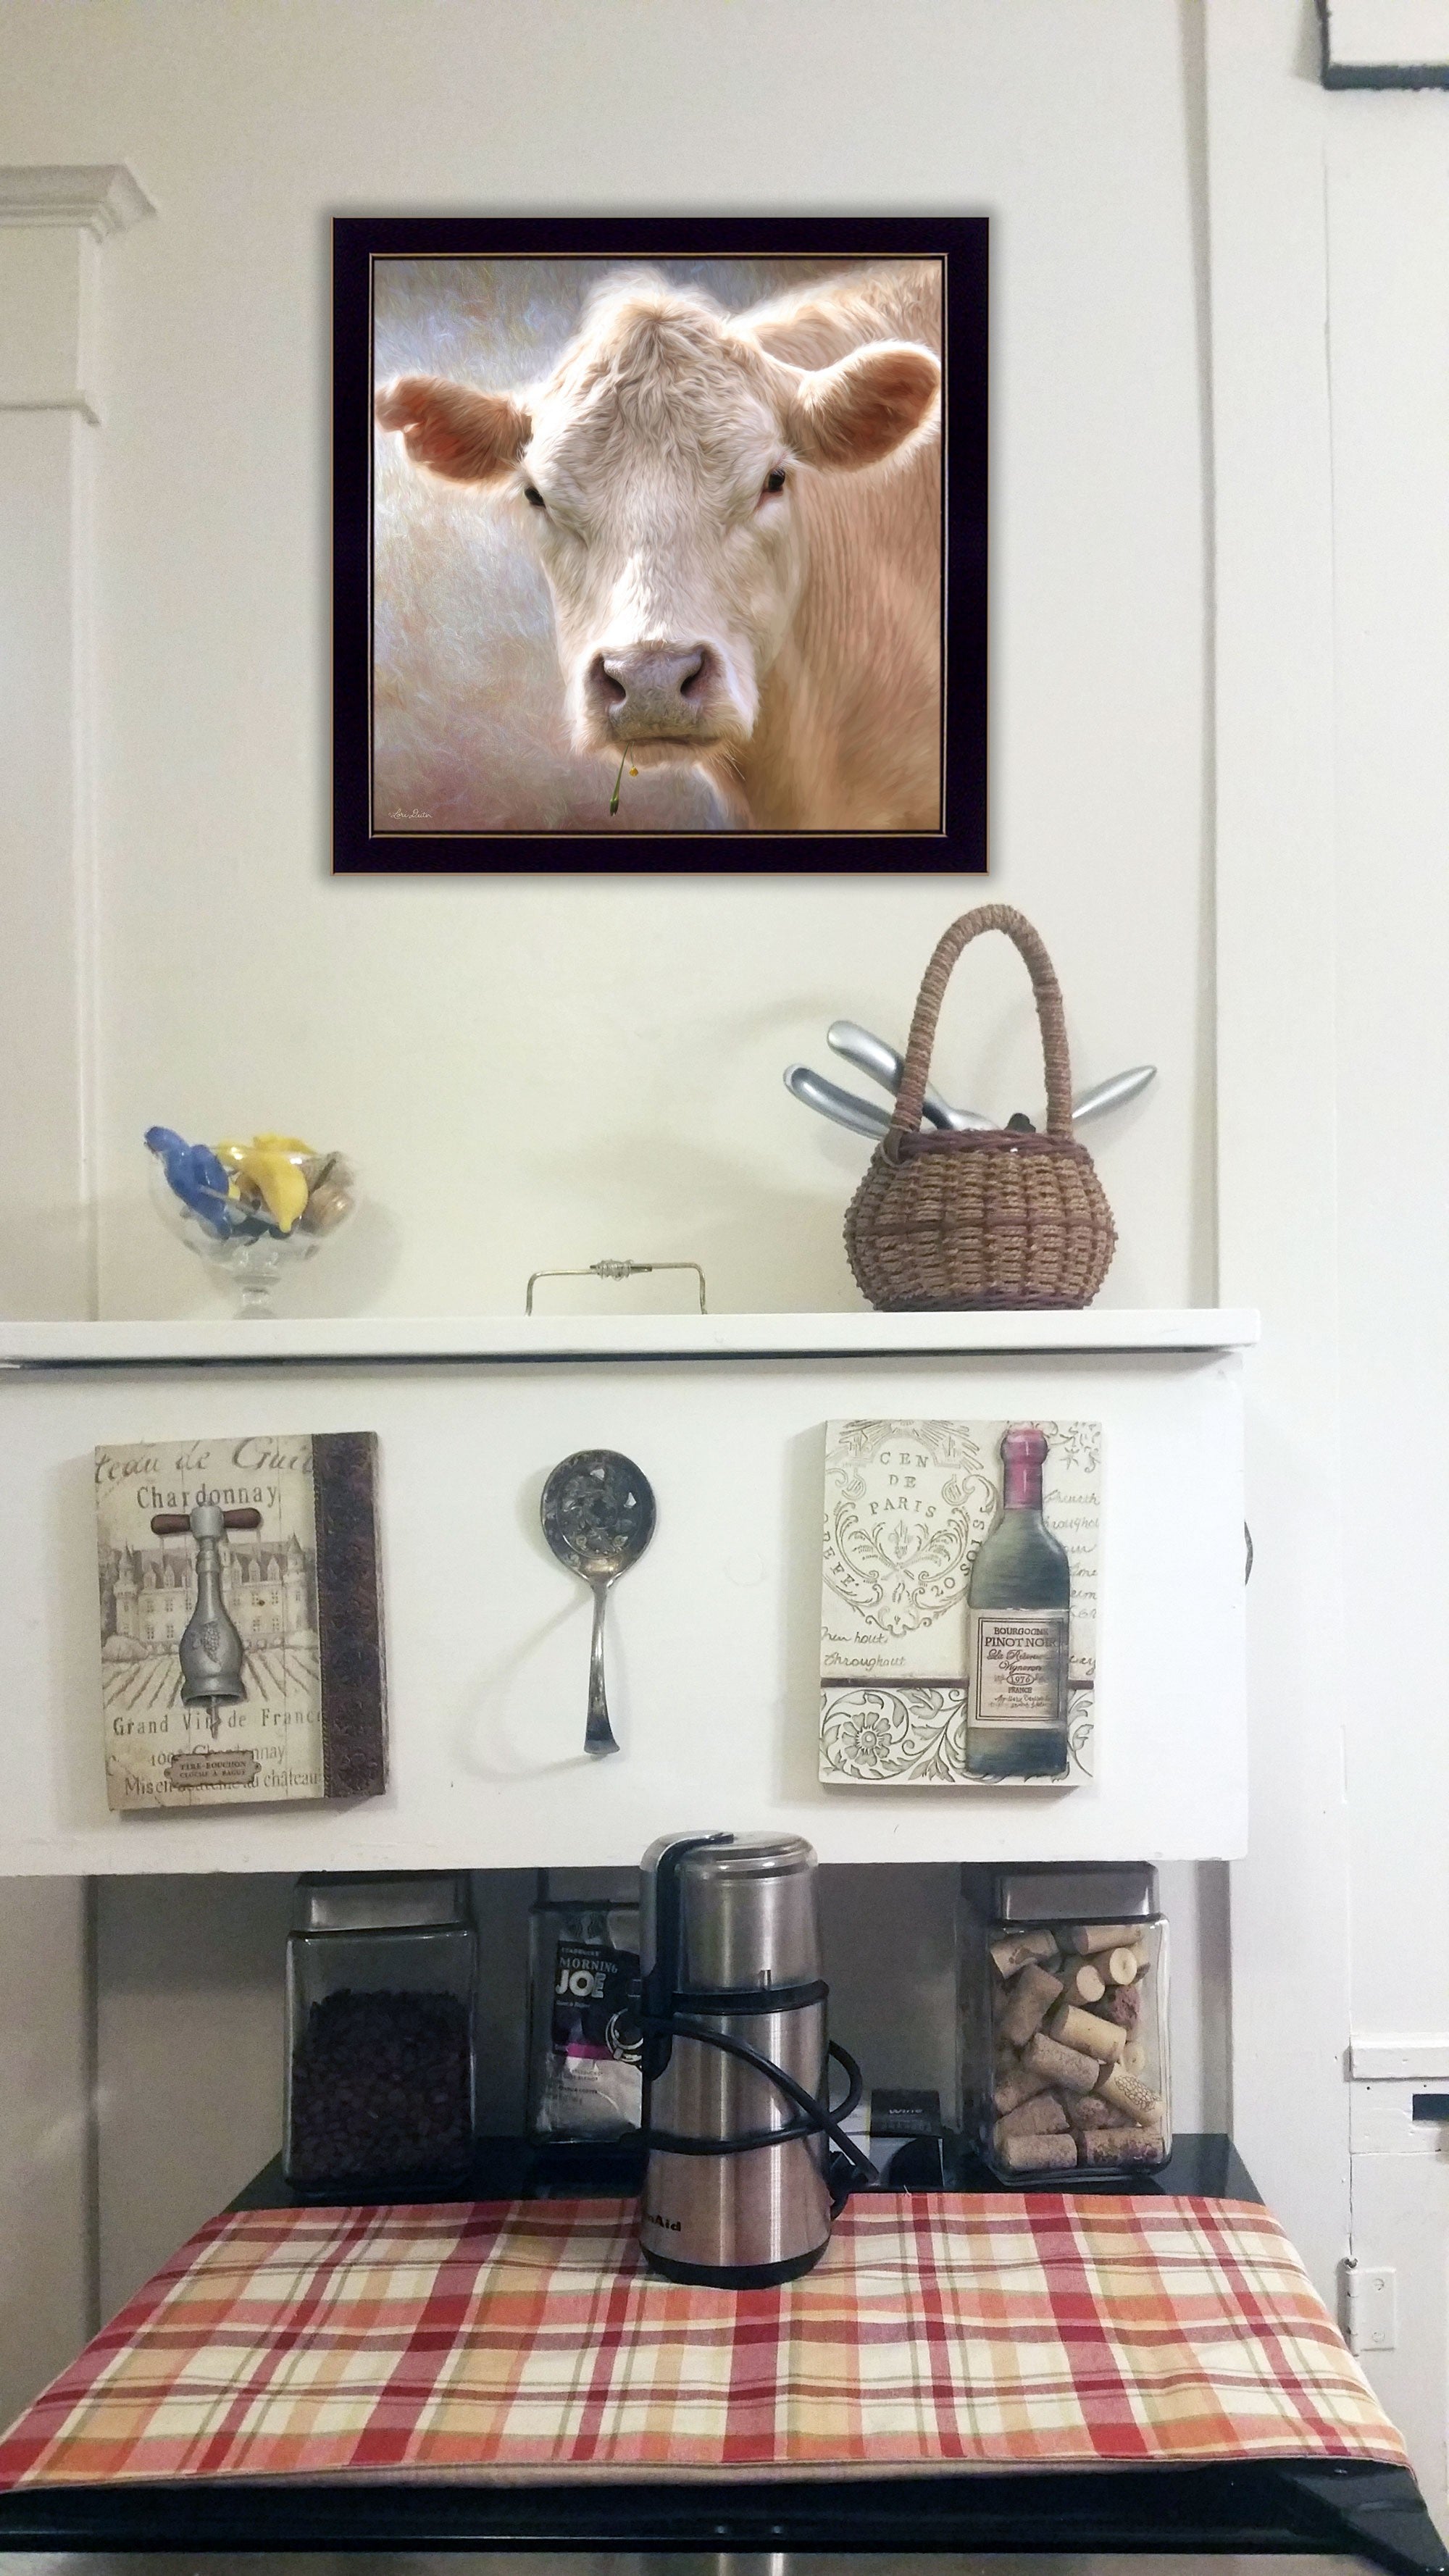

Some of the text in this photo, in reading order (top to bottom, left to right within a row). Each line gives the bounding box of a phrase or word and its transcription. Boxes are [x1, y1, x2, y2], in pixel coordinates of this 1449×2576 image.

[889, 1474, 916, 1488] DE
[137, 1483, 277, 1509] Chardonnay
[869, 1497, 937, 1518] PARIS
[985, 1636, 1056, 1647] PINOT NOIR
[1011, 1676, 1031, 1684] 1976
[113, 1714, 169, 1736] Grand
[228, 1709, 247, 1728] de
[560, 1957, 618, 1974] MORNING
[555, 1969, 606, 1999] JOE
